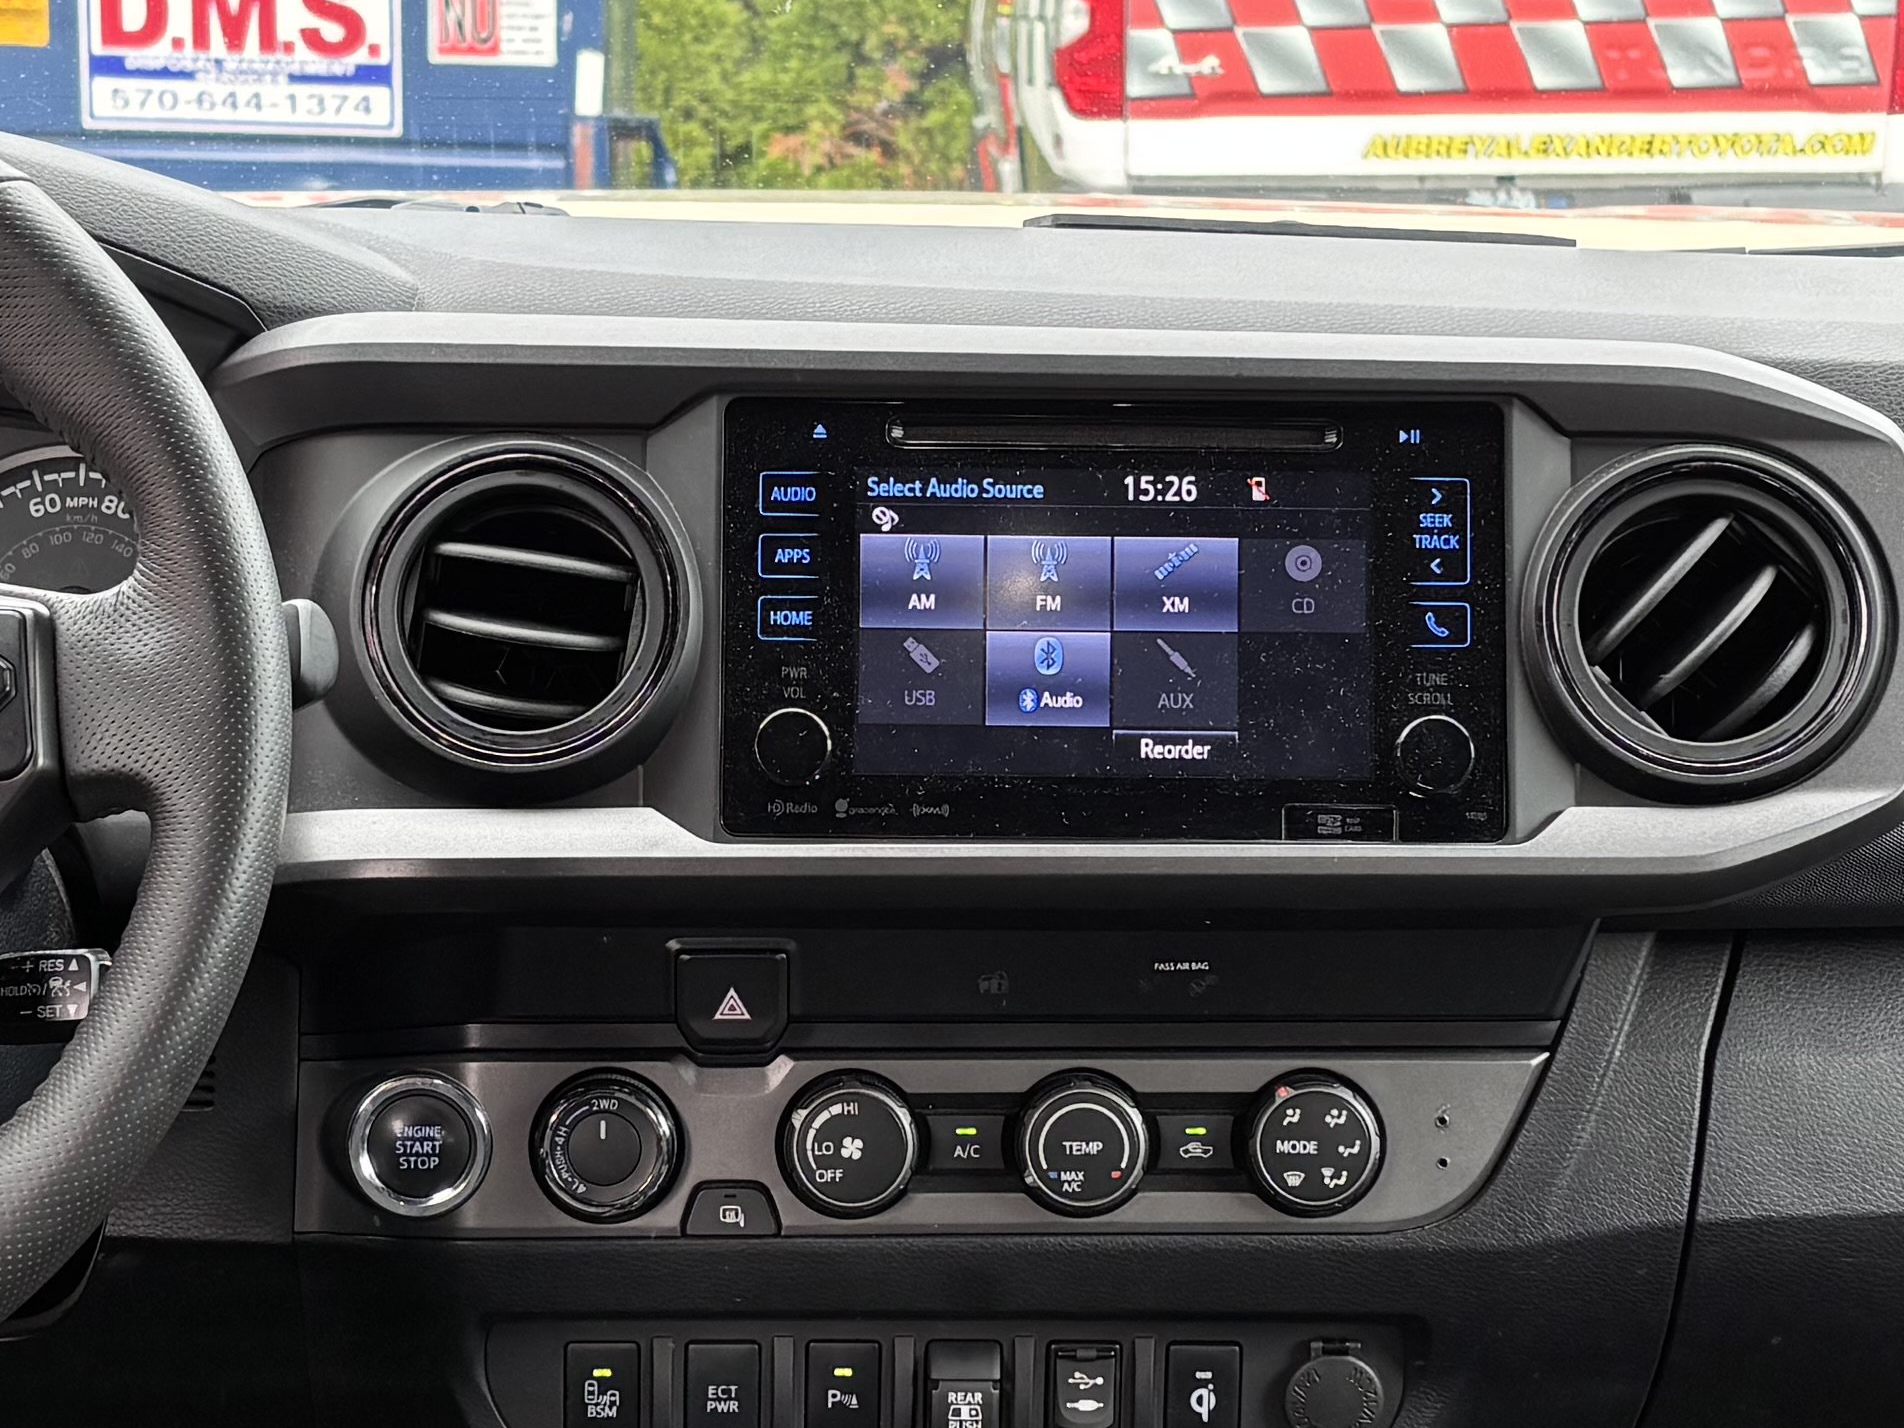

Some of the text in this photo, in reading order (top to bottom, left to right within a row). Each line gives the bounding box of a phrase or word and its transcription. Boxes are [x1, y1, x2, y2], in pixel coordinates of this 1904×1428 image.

[770, 486, 817, 502] AUDIO
[867, 477, 1045, 499] Select Audio Source
[1123, 476, 1198, 503] 15:26
[29, 492, 62, 518] 60
[65, 496, 98, 508] MPH
[66, 513, 98, 523] km/h
[1419, 513, 1453, 528] SEEK
[48, 531, 73, 546] 100
[82, 531, 105, 545] 120
[1412, 534, 1460, 550] TRACK
[21, 544, 40, 560] 80
[110, 539, 134, 558] 140
[774, 548, 811, 564] APPS
[908, 594, 936, 610] AM
[1035, 595, 1061, 611] FM
[1162, 597, 1189, 613] XM
[1292, 599, 1315, 614] CD
[770, 610, 813, 625] HOME
[781, 666, 807, 679] PWR
[1415, 673, 1448, 687] TUNE
[783, 686, 806, 699] VOL
[904, 690, 936, 706] USB
[1407, 692, 1451, 706] SCROLL
[1040, 692, 1084, 709] Audio
[1157, 693, 1194, 710] AUX
[1139, 738, 1212, 760] Reorder
[786, 802, 818, 814] Radio
[39, 959, 65, 972] RES
[1154, 961, 1210, 971] PASS AIR BAG
[0, 986, 27, 997] HOLD
[37, 1005, 63, 1018] SET
[590, 1098, 619, 1111] 2WD
[843, 1102, 859, 1116] HI
[396, 1126, 443, 1138] ENGINE
[555, 1126, 569, 1144] 4H
[395, 1140, 443, 1154] START
[814, 1142, 834, 1156] LO
[953, 1144, 981, 1159] A/C
[1062, 1141, 1104, 1155] TEMP
[1275, 1139, 1319, 1155] MODE
[399, 1156, 439, 1170] STOP
[815, 1169, 844, 1183] OFF
[1060, 1171, 1085, 1182] MAX
[1062, 1181, 1083, 1193] A/C
[708, 1385, 739, 1399] ECT
[947, 1391, 983, 1405] REAR
[587, 1406, 617, 1418] BSM
[706, 1401, 739, 1413] PWR
